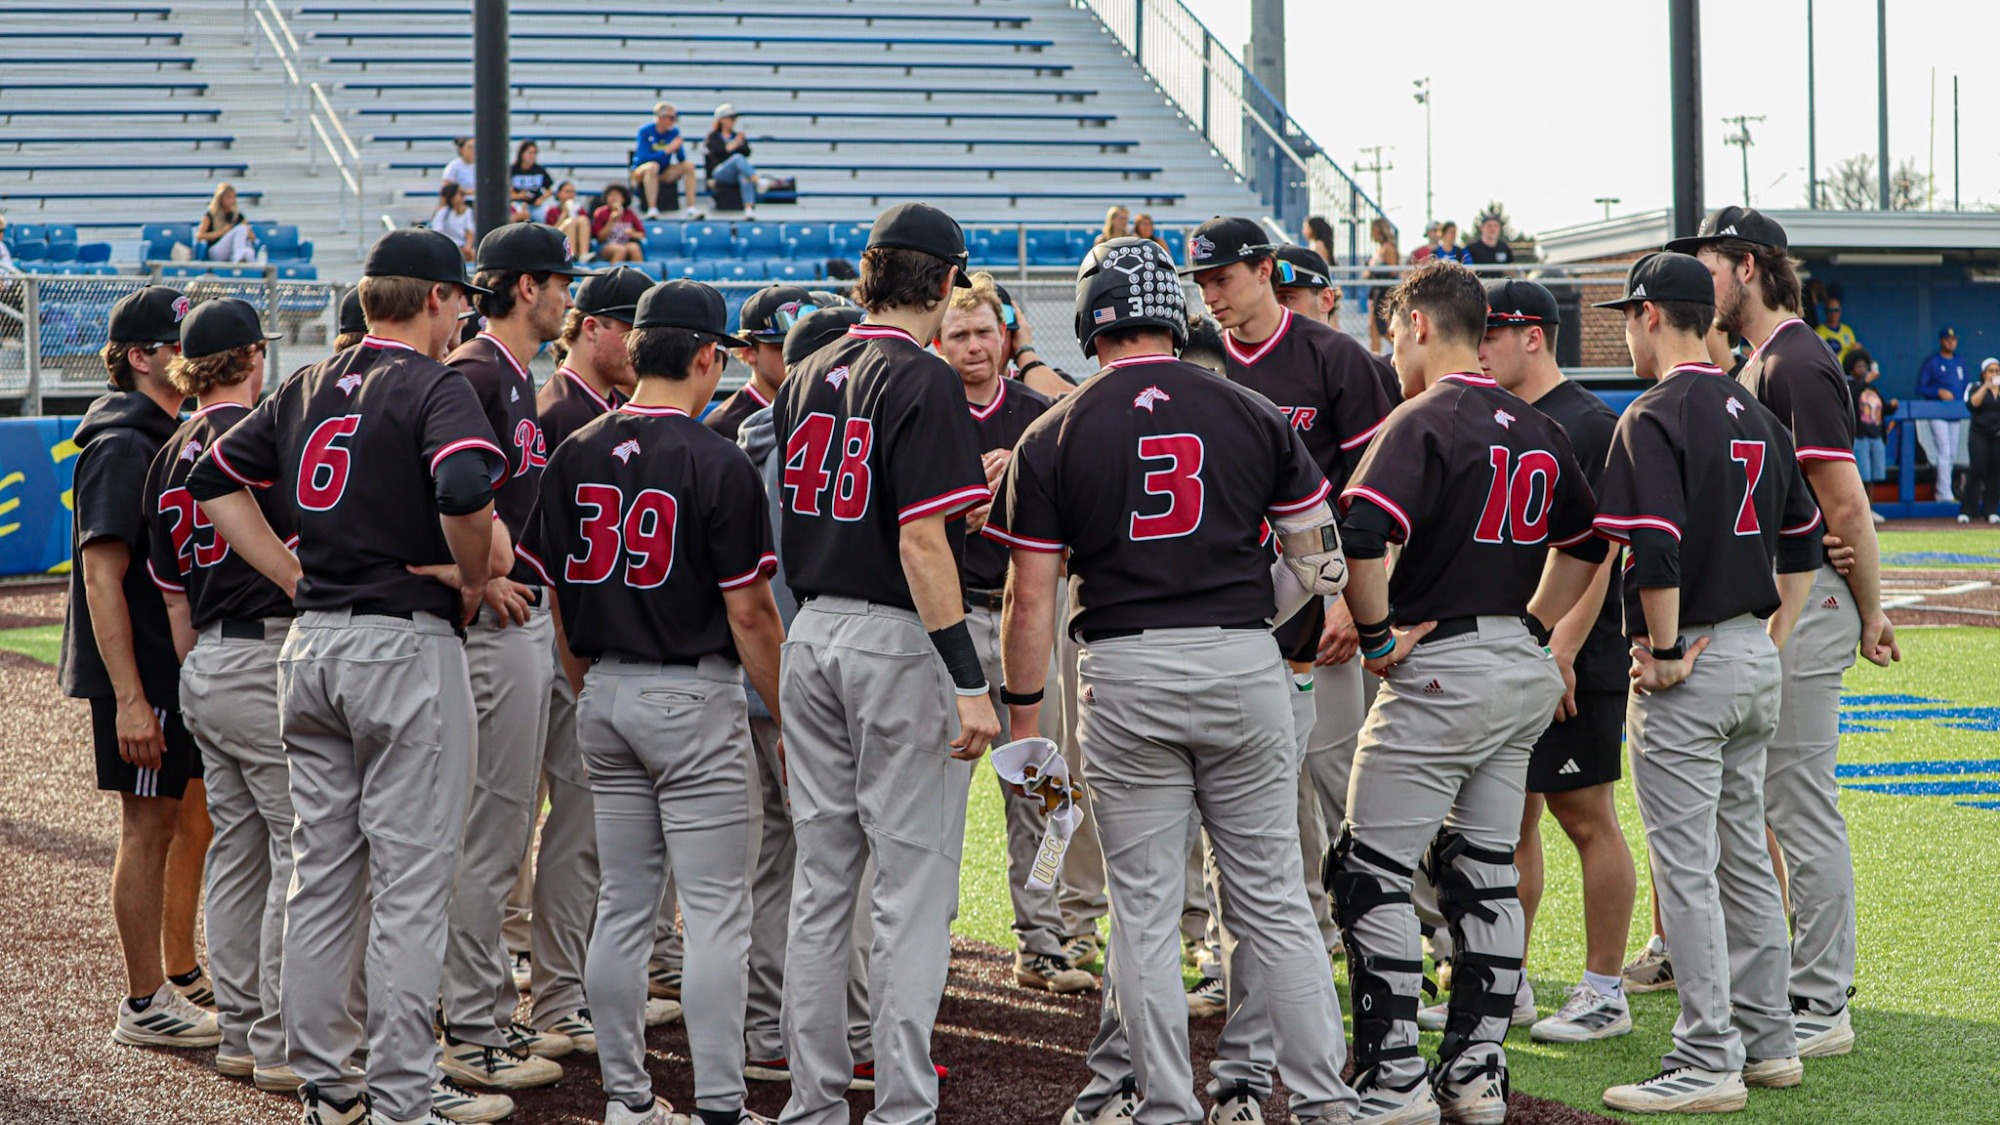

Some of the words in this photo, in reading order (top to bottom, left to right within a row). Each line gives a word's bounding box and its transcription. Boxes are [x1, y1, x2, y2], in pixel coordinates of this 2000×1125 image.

[1127, 296, 1144, 317] 3
[296, 414, 362, 511] 6
[784, 411, 873, 521] 48
[1129, 433, 1204, 541] 3
[1473, 445, 1560, 544] 10
[1730, 440, 1766, 536] 7
[565, 483, 678, 589] 39
[1033, 834, 1066, 885] UCC
